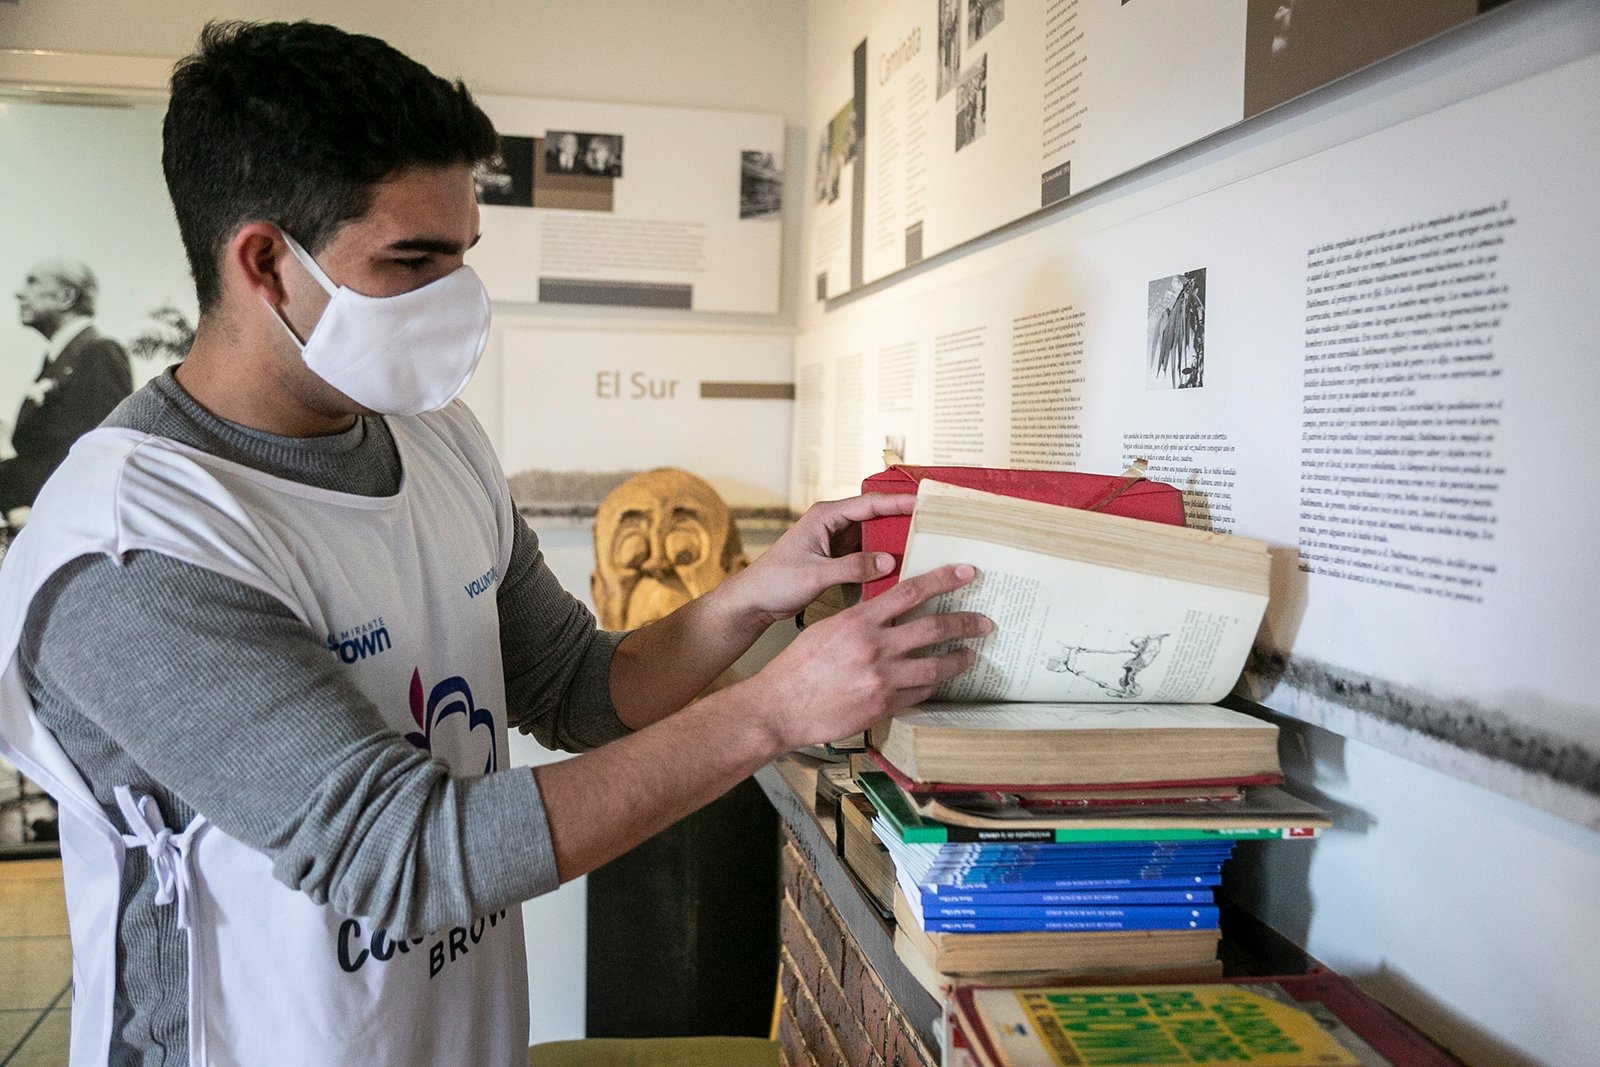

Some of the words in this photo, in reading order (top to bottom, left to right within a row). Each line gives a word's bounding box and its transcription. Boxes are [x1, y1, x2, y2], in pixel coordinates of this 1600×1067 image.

[878, 25, 922, 86] Caminata
[597, 371, 620, 398] El
[631, 371, 680, 399] Sur
[464, 566, 498, 599] VOLUNT
